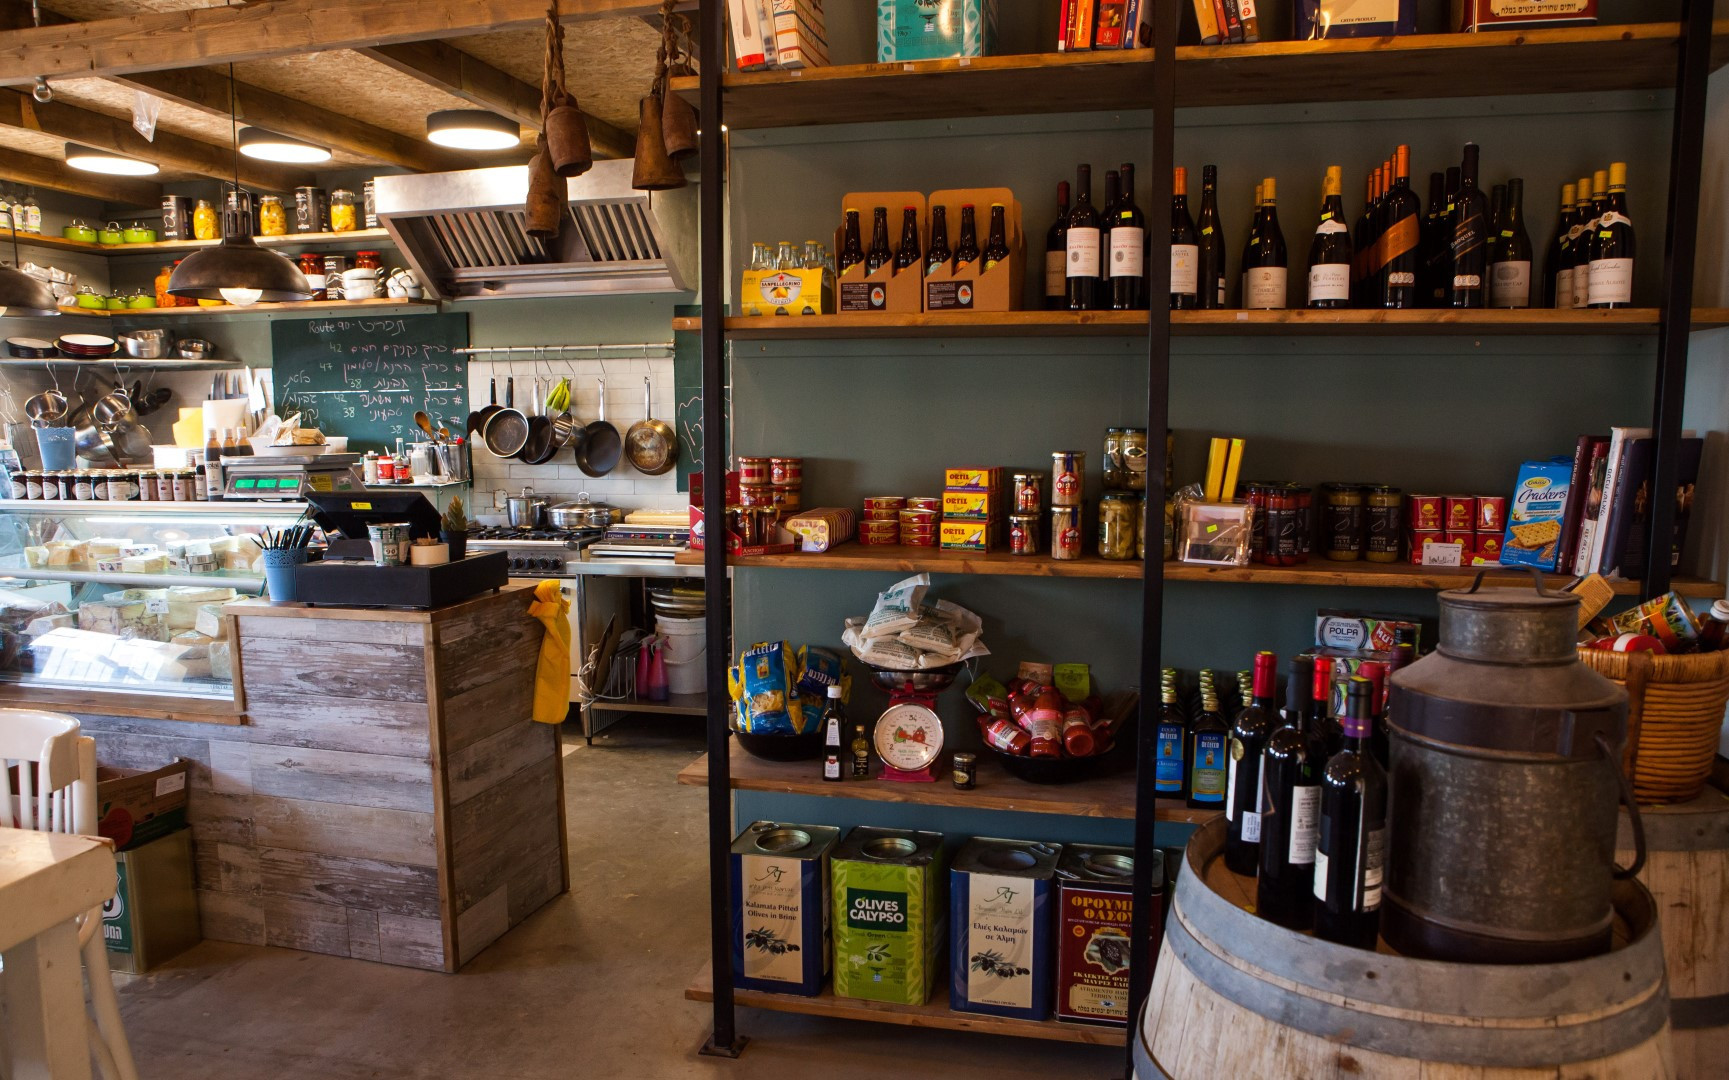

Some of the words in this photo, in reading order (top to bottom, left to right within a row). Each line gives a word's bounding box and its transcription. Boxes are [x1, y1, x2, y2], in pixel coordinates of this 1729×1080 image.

[1500, 6, 1516, 14] במלח
[309, 320, 335, 334] Route
[358, 320, 406, 336] תפריט
[330, 342, 342, 352] 42
[351, 344, 377, 354] חמים
[383, 344, 418, 358] נקניקים
[422, 344, 448, 360] כריך
[320, 363, 333, 372] 47
[421, 364, 448, 382] כריך
[349, 378, 362, 388] 38
[373, 377, 409, 390] גבינות
[334, 393, 347, 402] 42
[360, 394, 392, 407] משתנה
[400, 395, 414, 404] יומי
[424, 397, 448, 411] כריך
[343, 407, 355, 418] 38
[369, 408, 402, 422] טבעוני
[390, 425, 403, 434] 38
[1518, 488, 1567, 503] Crackers
[792, 520, 819, 528] ORTIZ
[692, 537, 704, 545] ORT
[1329, 627, 1358, 636] POLPA
[1376, 628, 1394, 646] MUT
[746, 901, 777, 910] Kalamata
[855, 898, 898, 911] OLIVES
[850, 909, 904, 923] CALYPSO
[974, 923, 991, 932] Ελιές
[994, 925, 1028, 935] Καλαμών
[997, 934, 1016, 944] Άλμη
